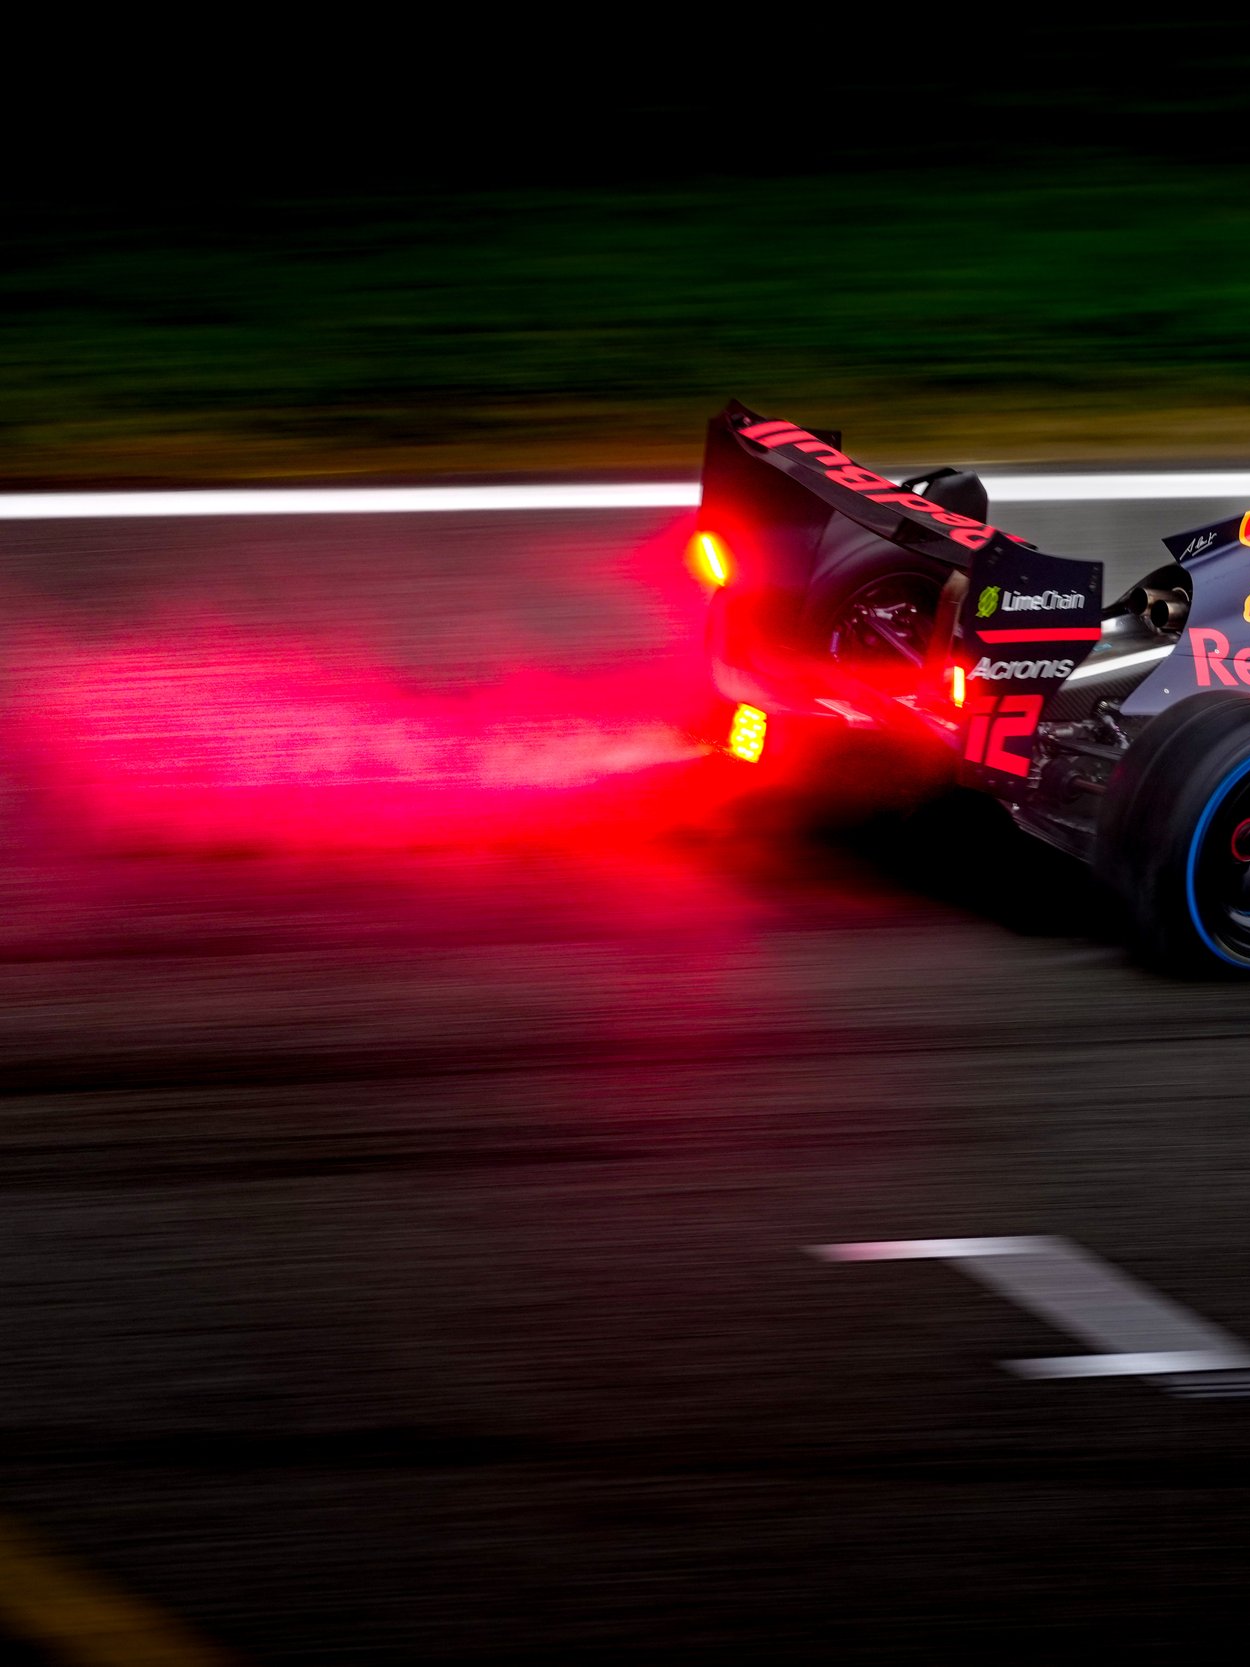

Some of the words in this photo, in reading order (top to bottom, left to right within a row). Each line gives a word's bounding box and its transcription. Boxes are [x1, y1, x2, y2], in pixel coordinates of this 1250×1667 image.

[737, 419, 901, 491] Bull
[1001, 590, 1086, 612] LimeChain
[967, 657, 1075, 681] Acronis
[964, 694, 1045, 779] 12
